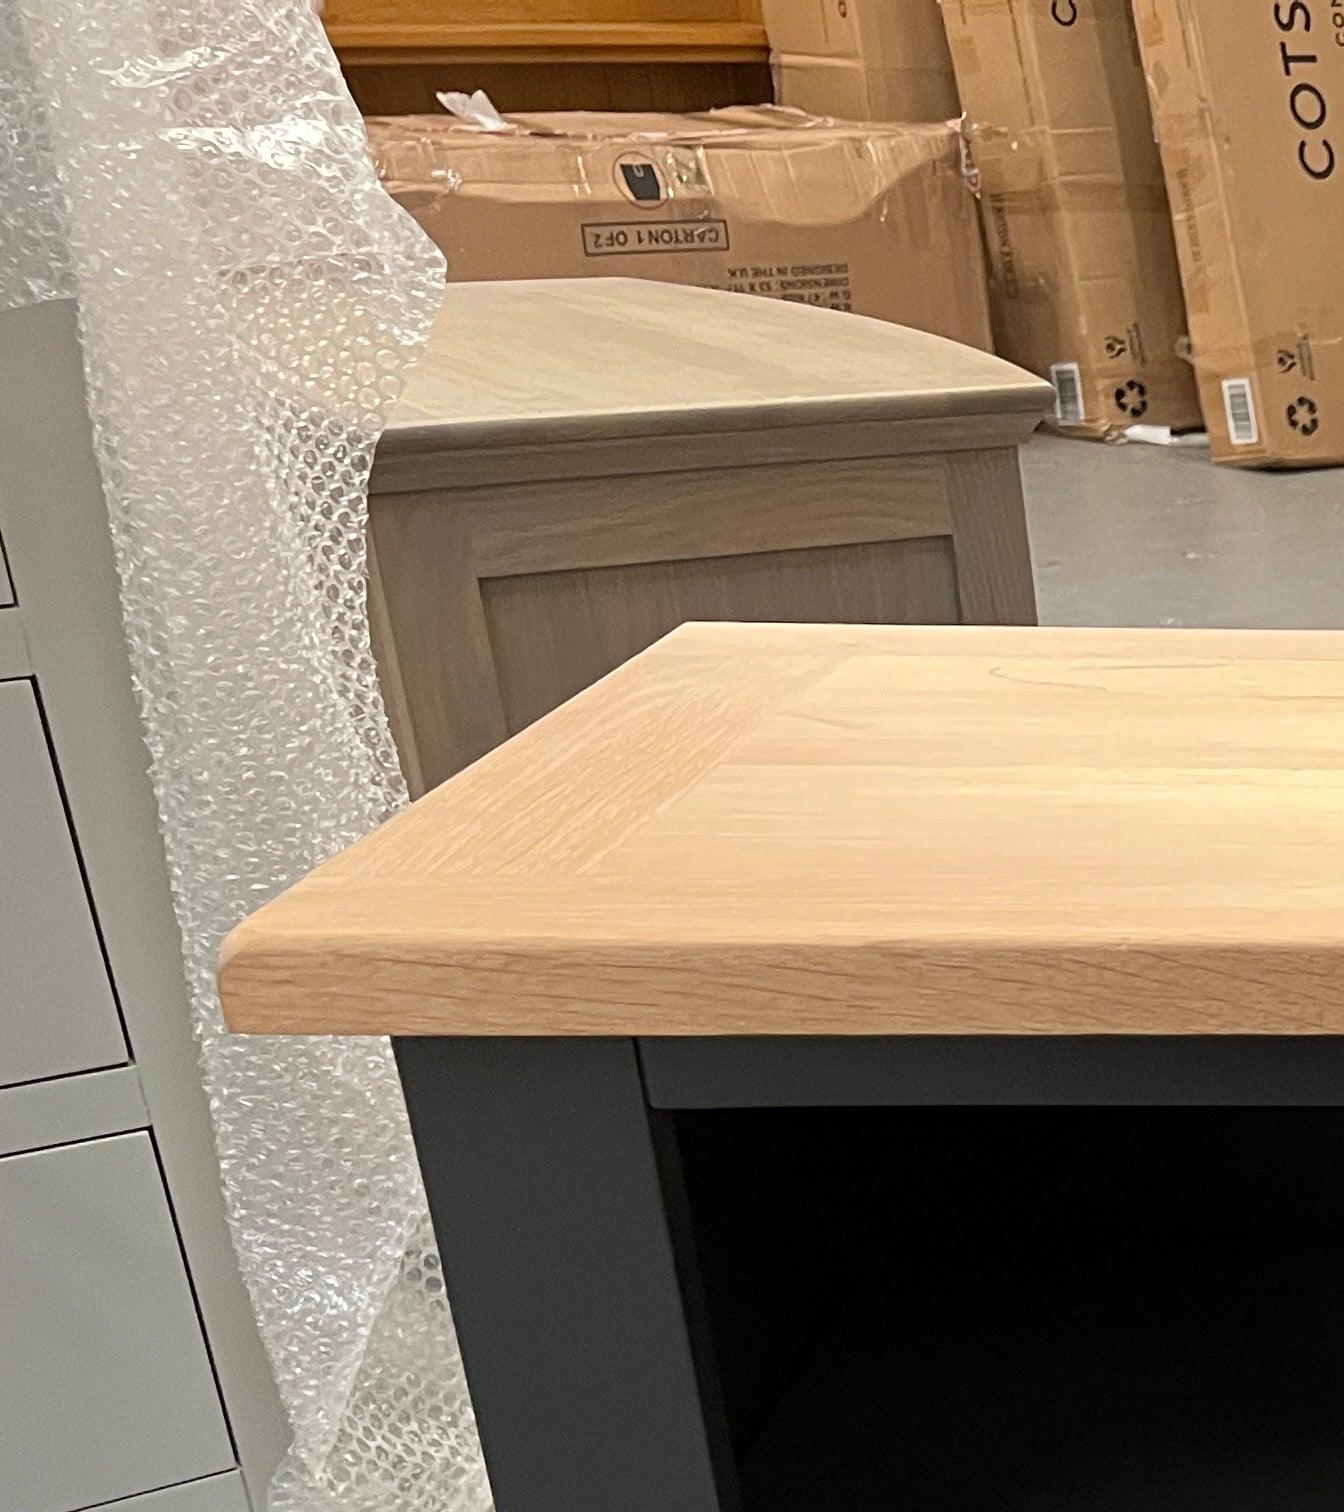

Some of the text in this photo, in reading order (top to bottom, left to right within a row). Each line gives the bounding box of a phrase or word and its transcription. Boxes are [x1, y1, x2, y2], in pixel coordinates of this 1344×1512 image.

[605, 230, 628, 247] OF
[636, 230, 645, 244] 1
[649, 227, 719, 245] CARTON
